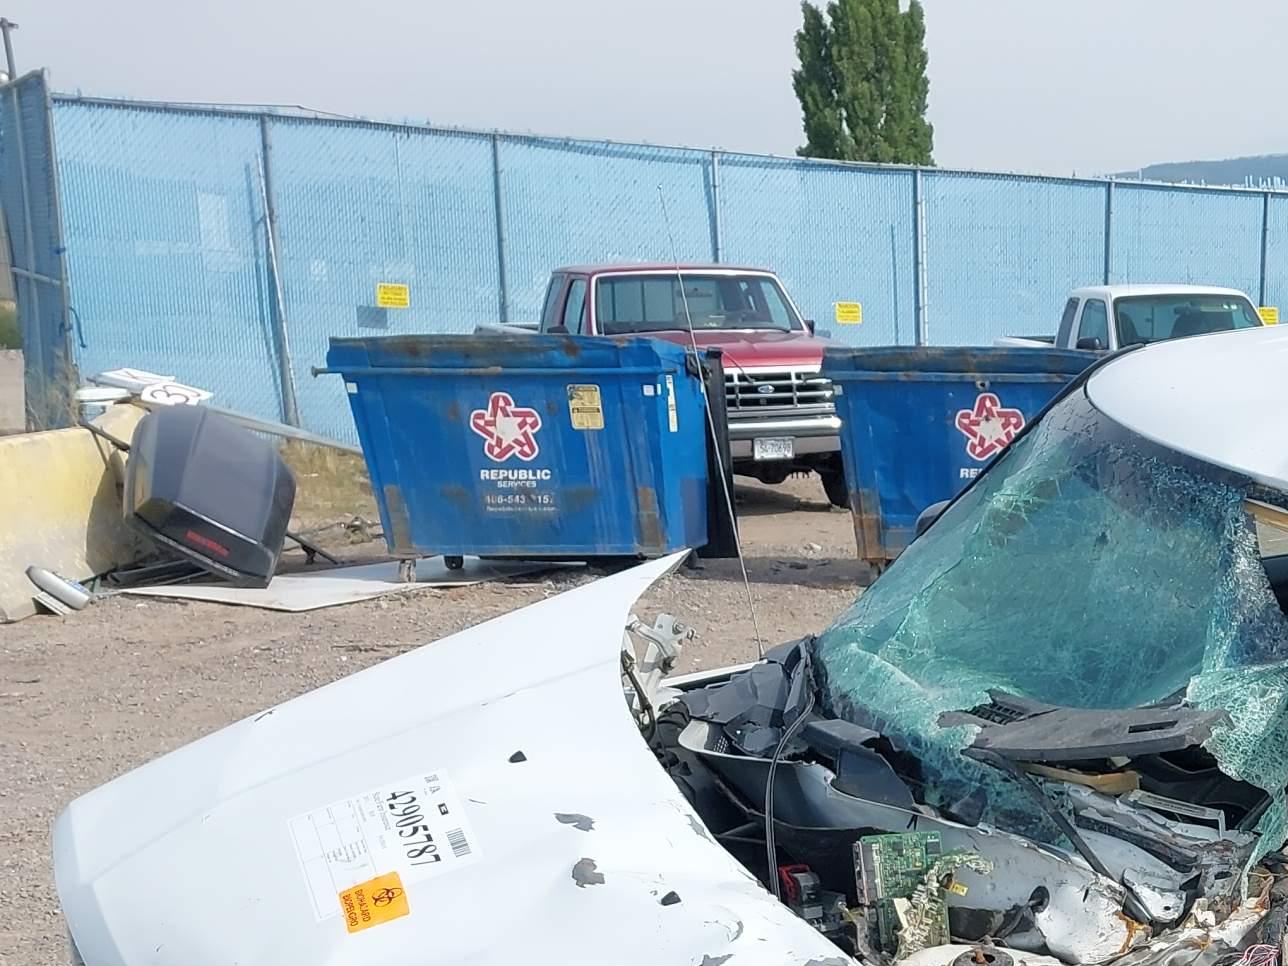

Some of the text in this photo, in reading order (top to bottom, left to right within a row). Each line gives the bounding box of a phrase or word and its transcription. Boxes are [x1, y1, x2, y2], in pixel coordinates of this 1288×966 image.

[480, 469, 551, 481] REPUBLIC
[960, 467, 983, 479] RE
[497, 481, 537, 489] SERVICES
[386, 790, 441, 867] 42905787
[342, 894, 358, 927] BIOPELIGRO
[355, 888, 371, 922] BIOHAZARD
